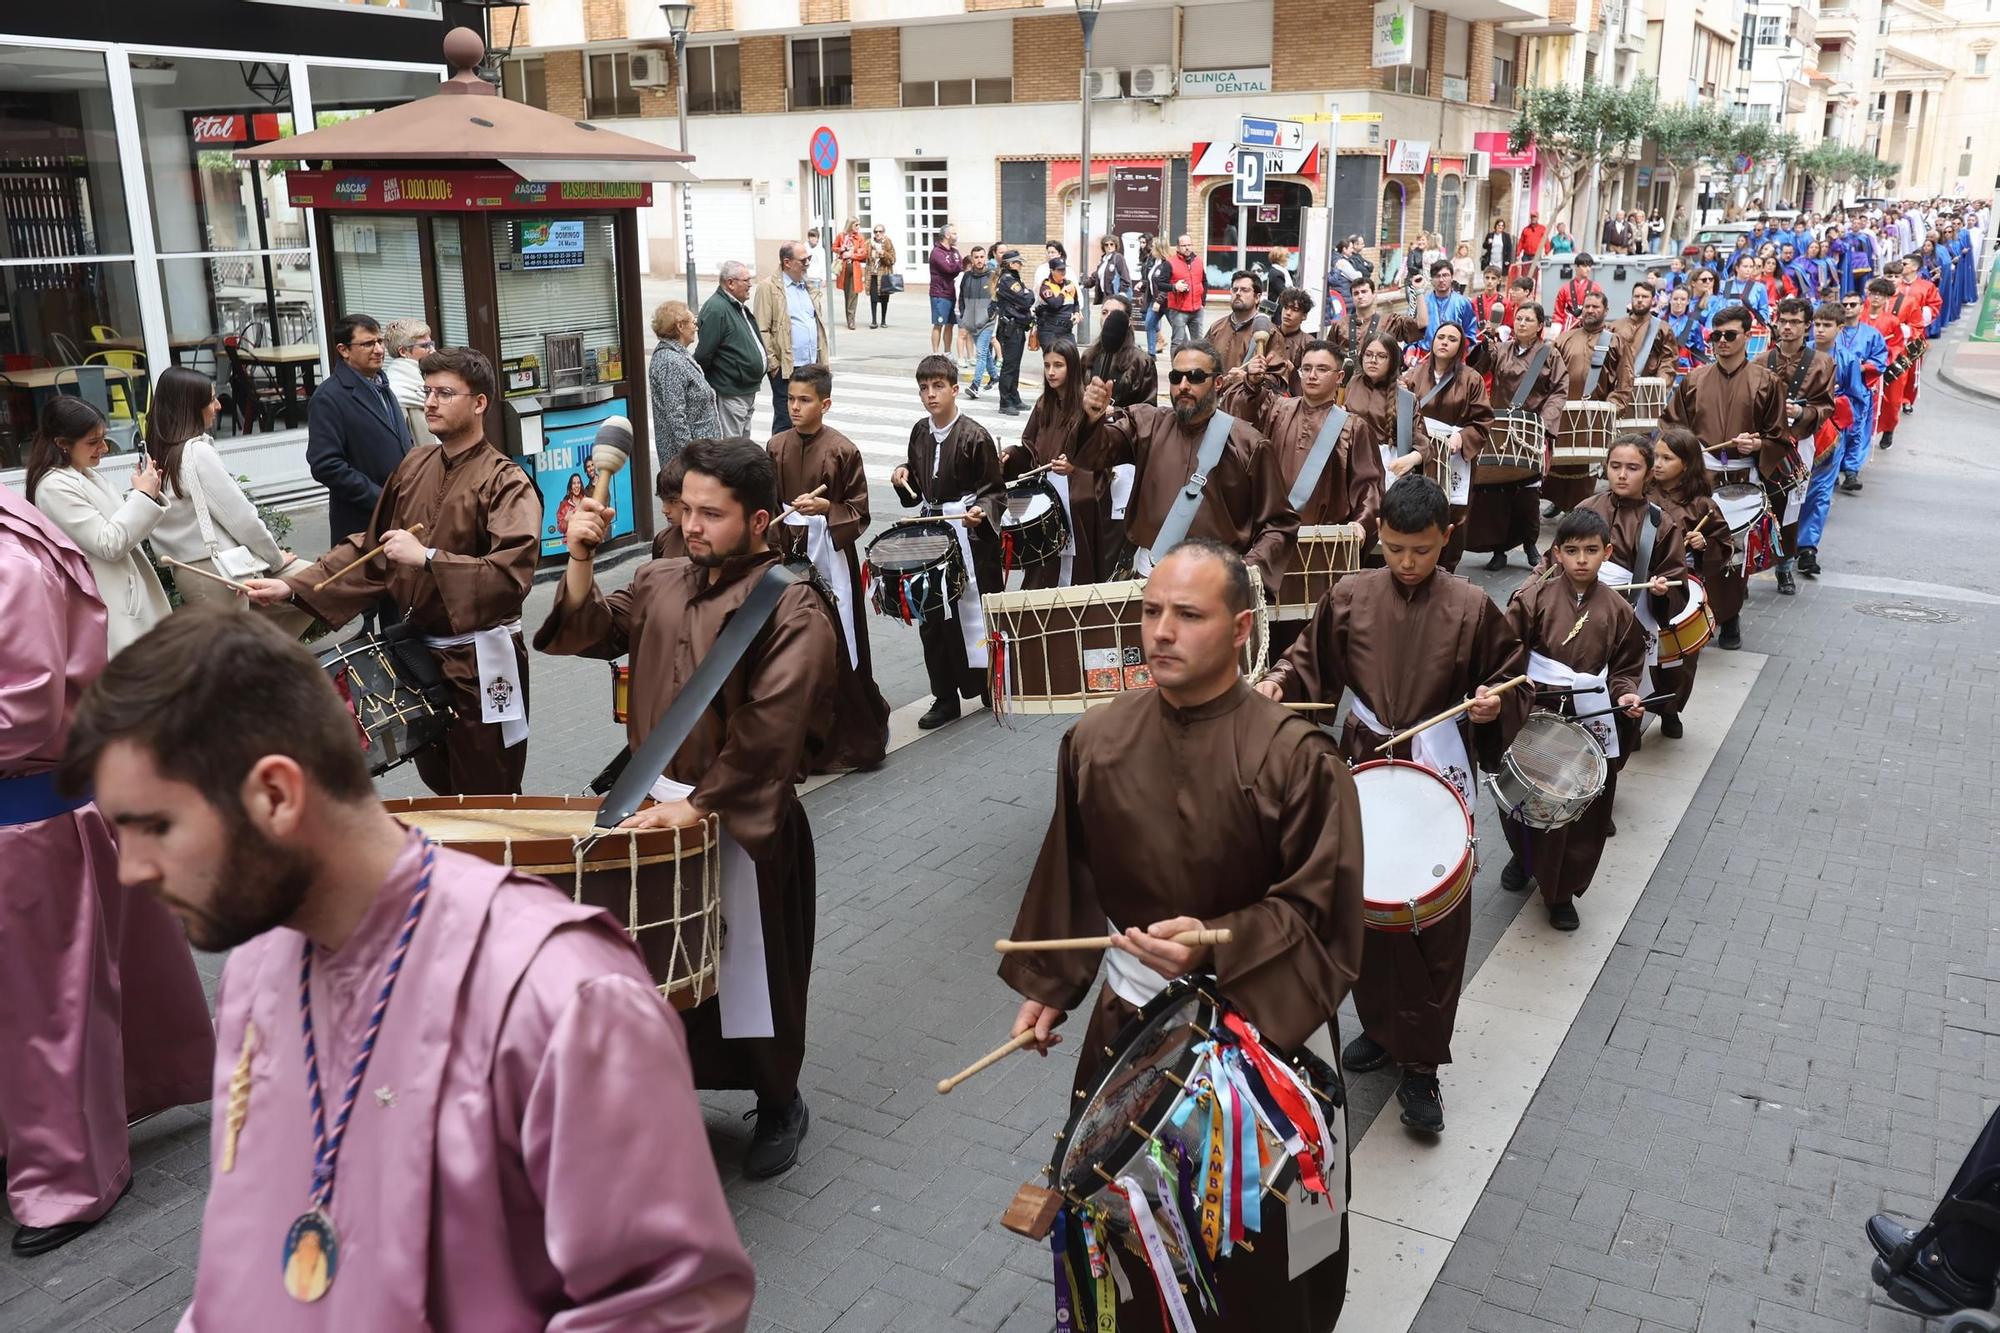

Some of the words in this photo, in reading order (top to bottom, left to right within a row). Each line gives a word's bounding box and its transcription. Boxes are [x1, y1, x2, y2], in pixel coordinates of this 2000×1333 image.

[1184, 72, 1237, 83] CLINICA
[1215, 82, 1267, 93] DENTAL
[336, 183, 367, 194] RASCAS
[383, 177, 398, 191] GANA
[514, 183, 547, 195] RASCAS
[561, 181, 591, 199] RASCA
[592, 181, 602, 199] EL
[602, 181, 642, 199] MOMENTO
[555, 231, 580, 239] DOMINGO
[536, 447, 572, 473] BIEN
